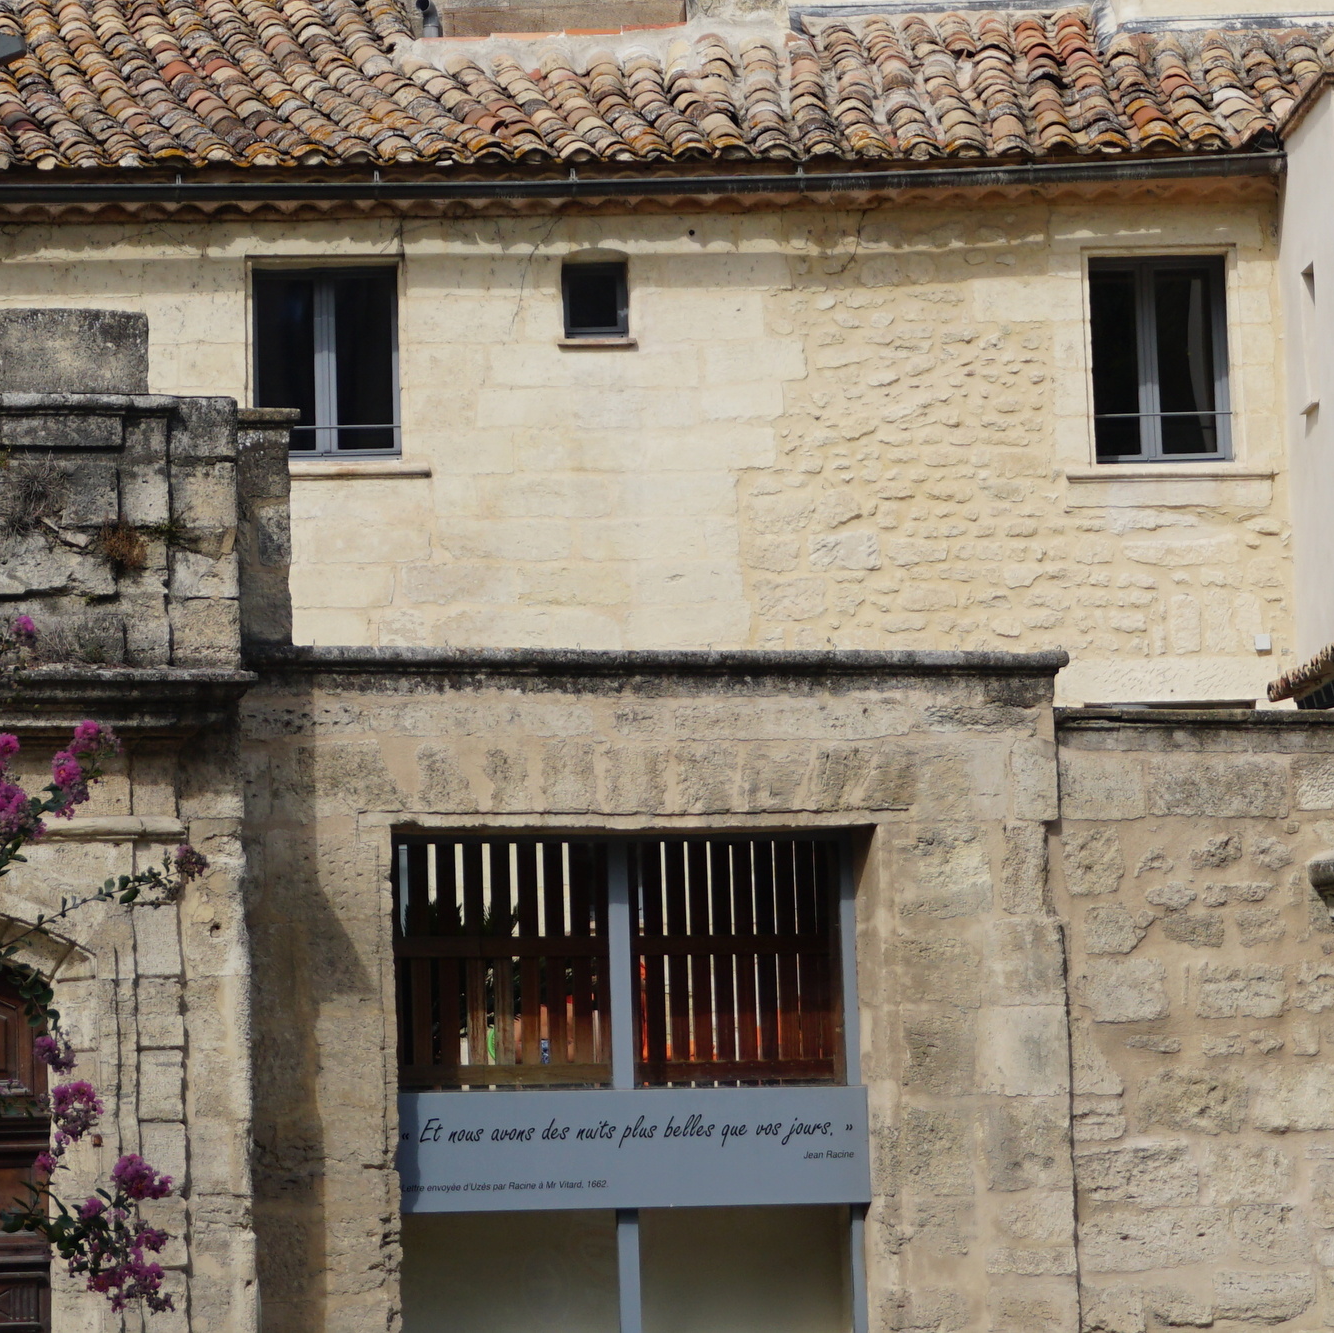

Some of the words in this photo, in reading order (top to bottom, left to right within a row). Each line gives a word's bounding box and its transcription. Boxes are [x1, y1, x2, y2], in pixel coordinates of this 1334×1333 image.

[419, 1117, 443, 1143] Et
[448, 1125, 484, 1143] nous
[490, 1124, 536, 1143] avons
[541, 1117, 570, 1142] des
[576, 1120, 617, 1141] nuits
[618, 1114, 658, 1148] plus
[663, 1113, 715, 1138] belles
[721, 1123, 747, 1147] que
[755, 1122, 782, 1136] vos
[781, 1117, 833, 1146] jours.
[803, 1151, 824, 1160] Jean
[825, 1149, 855, 1159] Racine
[401, 1183, 425, 1193] Lettre
[426, 1182, 461, 1194] envoyée
[492, 1183, 507, 1192] par
[508, 1181, 536, 1191] Racine
[538, 1181, 544, 1190] à
[545, 1181, 557, 1189] Mr
